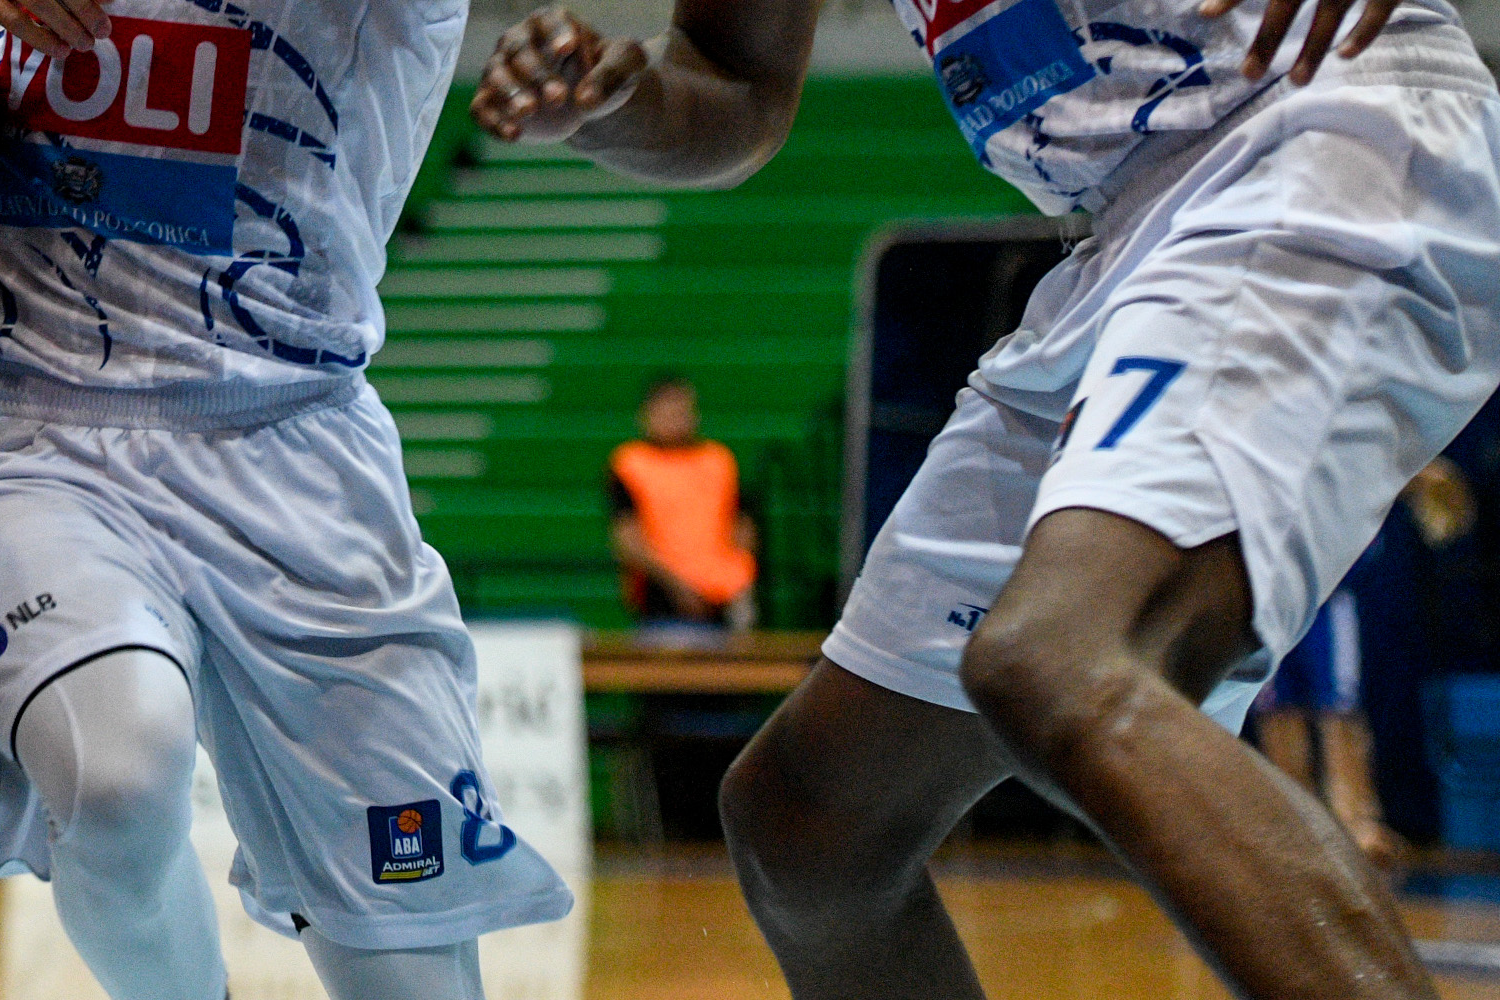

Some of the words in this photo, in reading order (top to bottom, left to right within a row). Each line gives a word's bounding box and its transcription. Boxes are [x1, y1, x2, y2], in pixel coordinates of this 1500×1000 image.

[7, 34, 218, 136] VOLI
[1093, 356, 1188, 451] 7
[6, 592, 58, 631] NLB
[394, 835, 421, 857] ABA
[451, 769, 518, 867] 8
[382, 856, 441, 873] ADMIRAL
